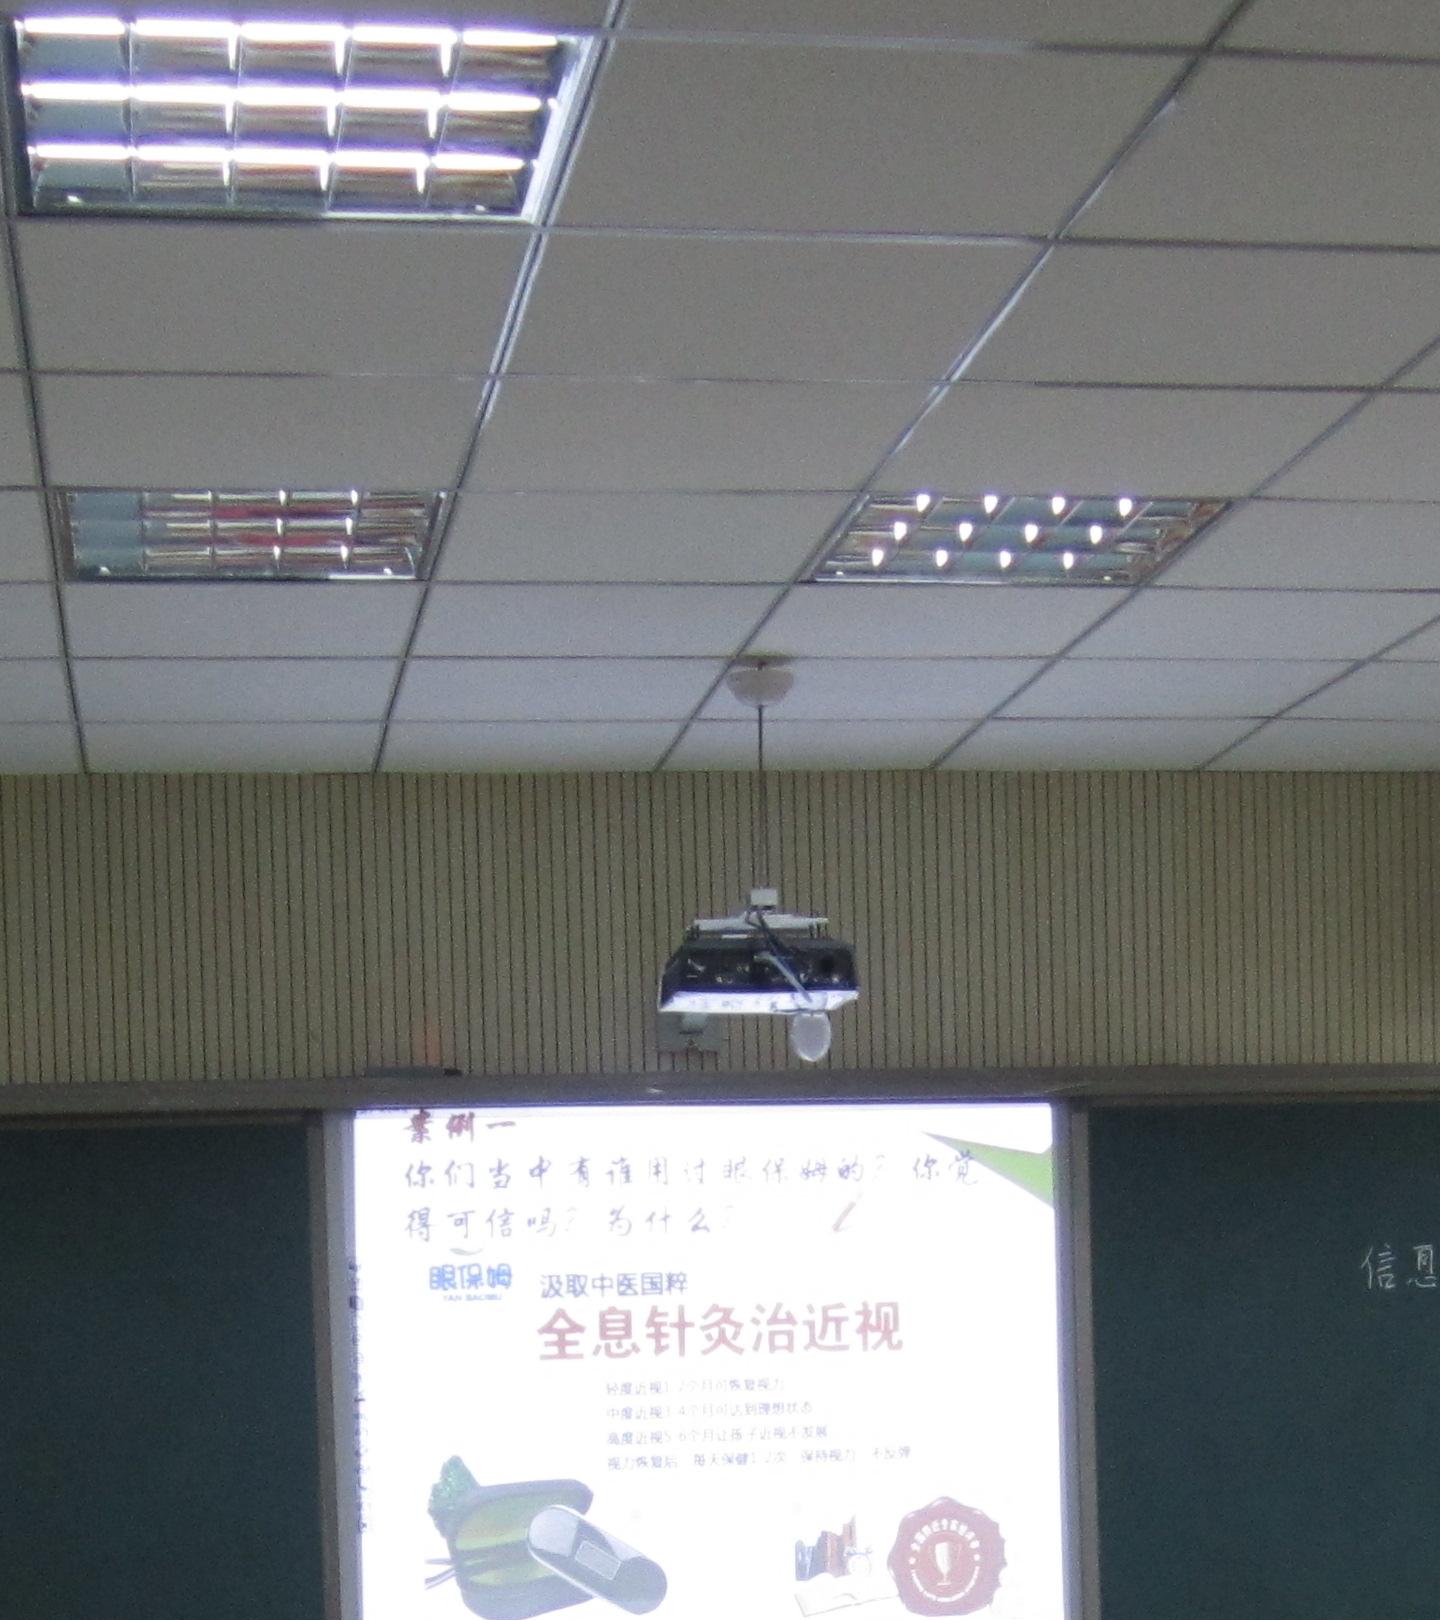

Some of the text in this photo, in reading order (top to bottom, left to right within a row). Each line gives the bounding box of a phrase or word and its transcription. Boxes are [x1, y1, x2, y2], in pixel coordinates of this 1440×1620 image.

[428, 1262, 513, 1291] 眼保姆
[539, 1271, 688, 1298] 汲取中医国粹
[536, 1301, 903, 1360] 全息针灸治近视
